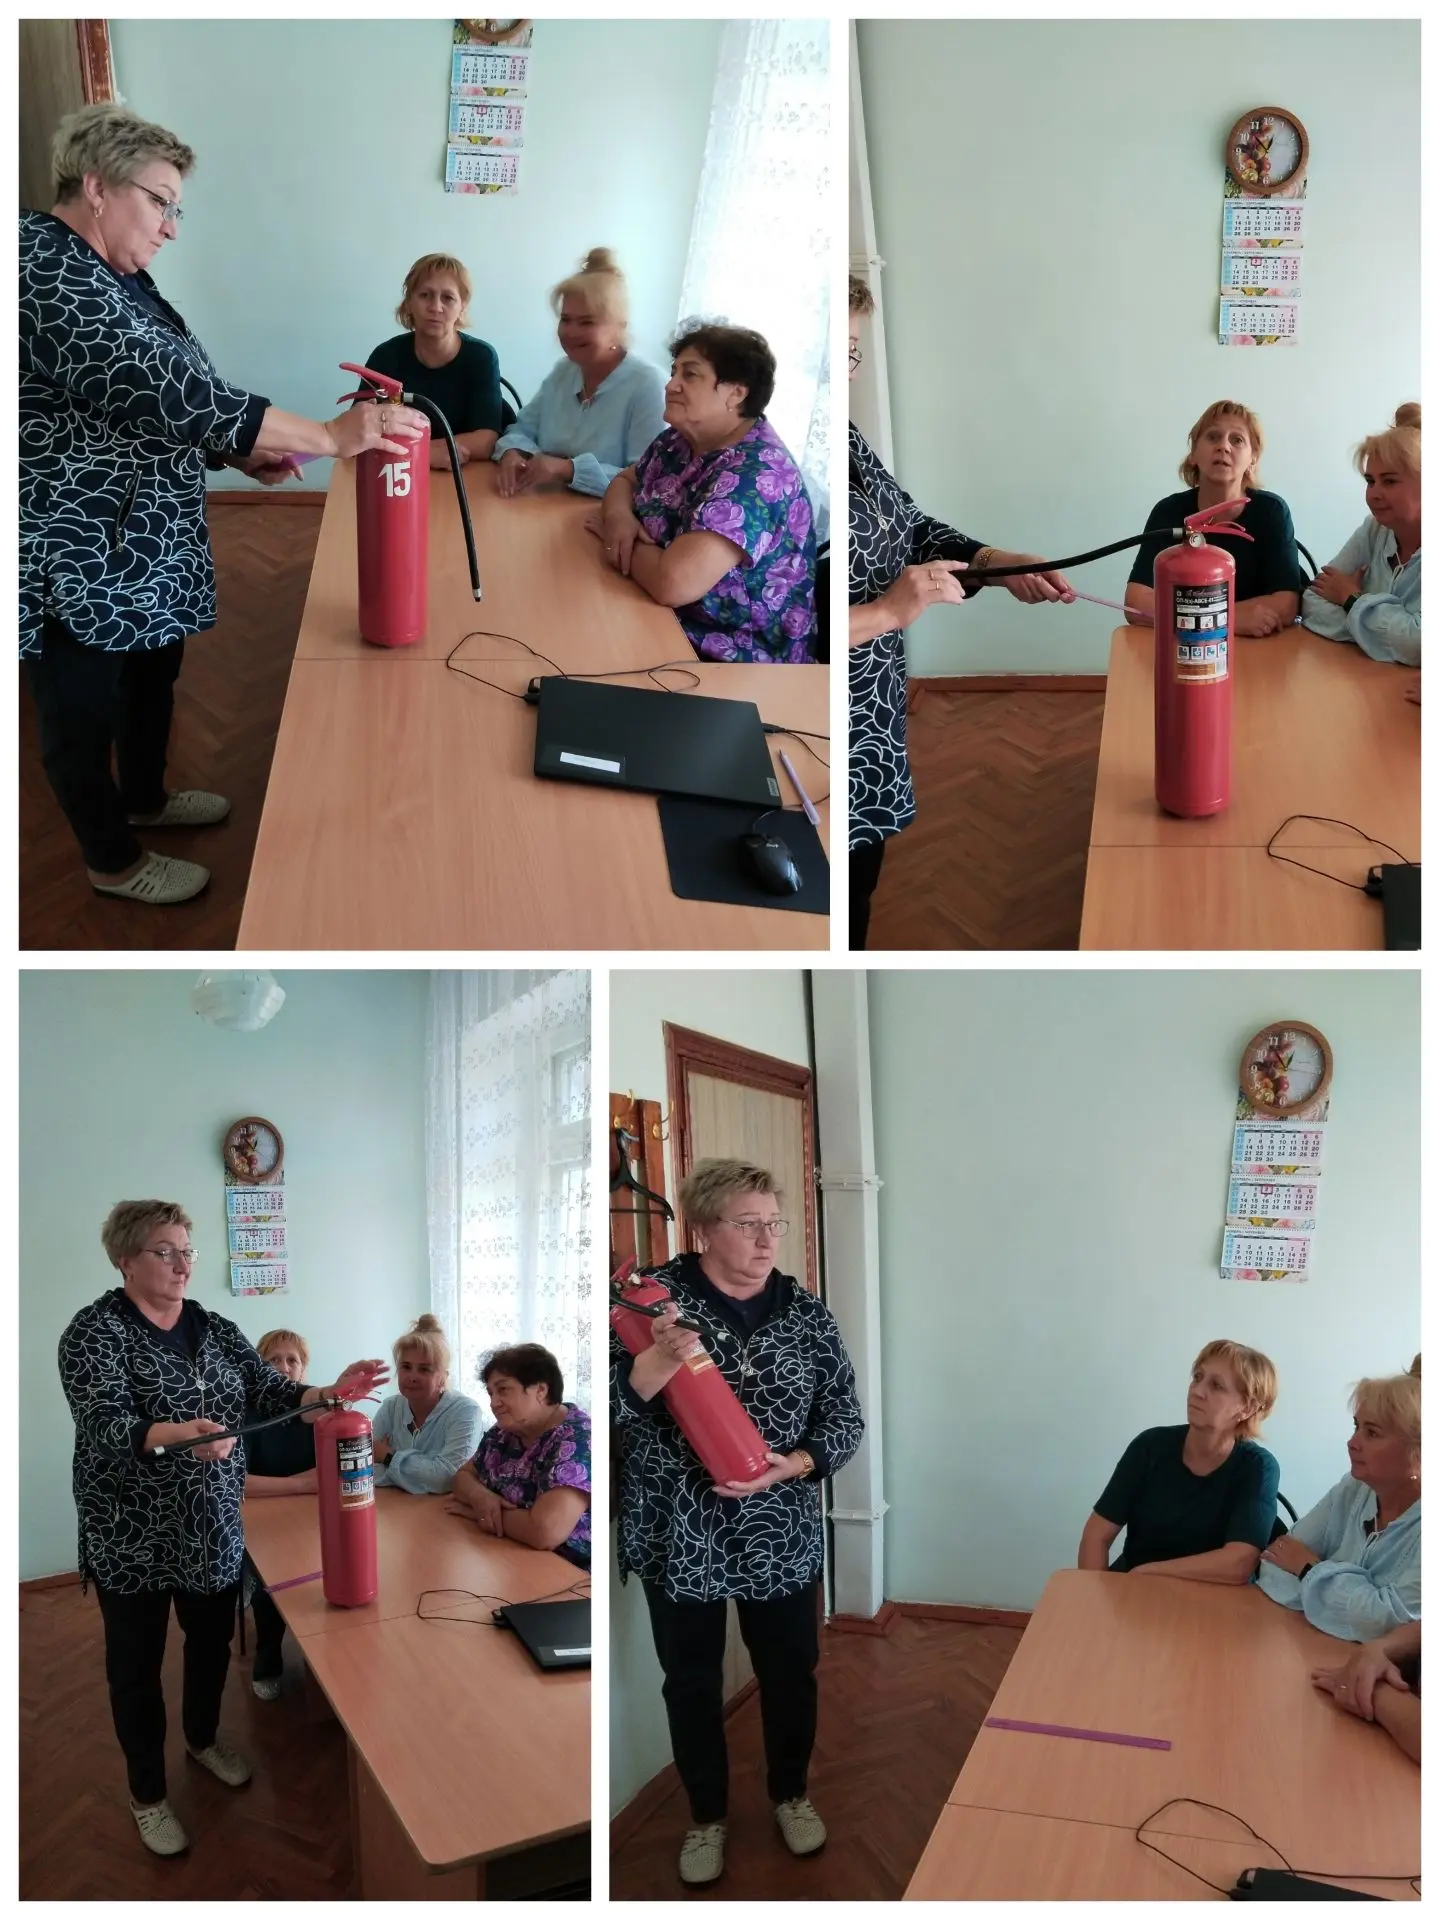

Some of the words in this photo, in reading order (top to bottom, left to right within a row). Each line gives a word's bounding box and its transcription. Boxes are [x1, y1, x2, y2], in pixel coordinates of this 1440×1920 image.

[1264, 117, 1274, 125] 12
[378, 462, 410, 496] 15
[1269, 1036, 1278, 1045] 11
[1284, 1032, 1296, 1040] 12
[1257, 1050, 1267, 1058] 10
[1251, 1065, 1257, 1074] 9
[1280, 1096, 1286, 1106] 6
